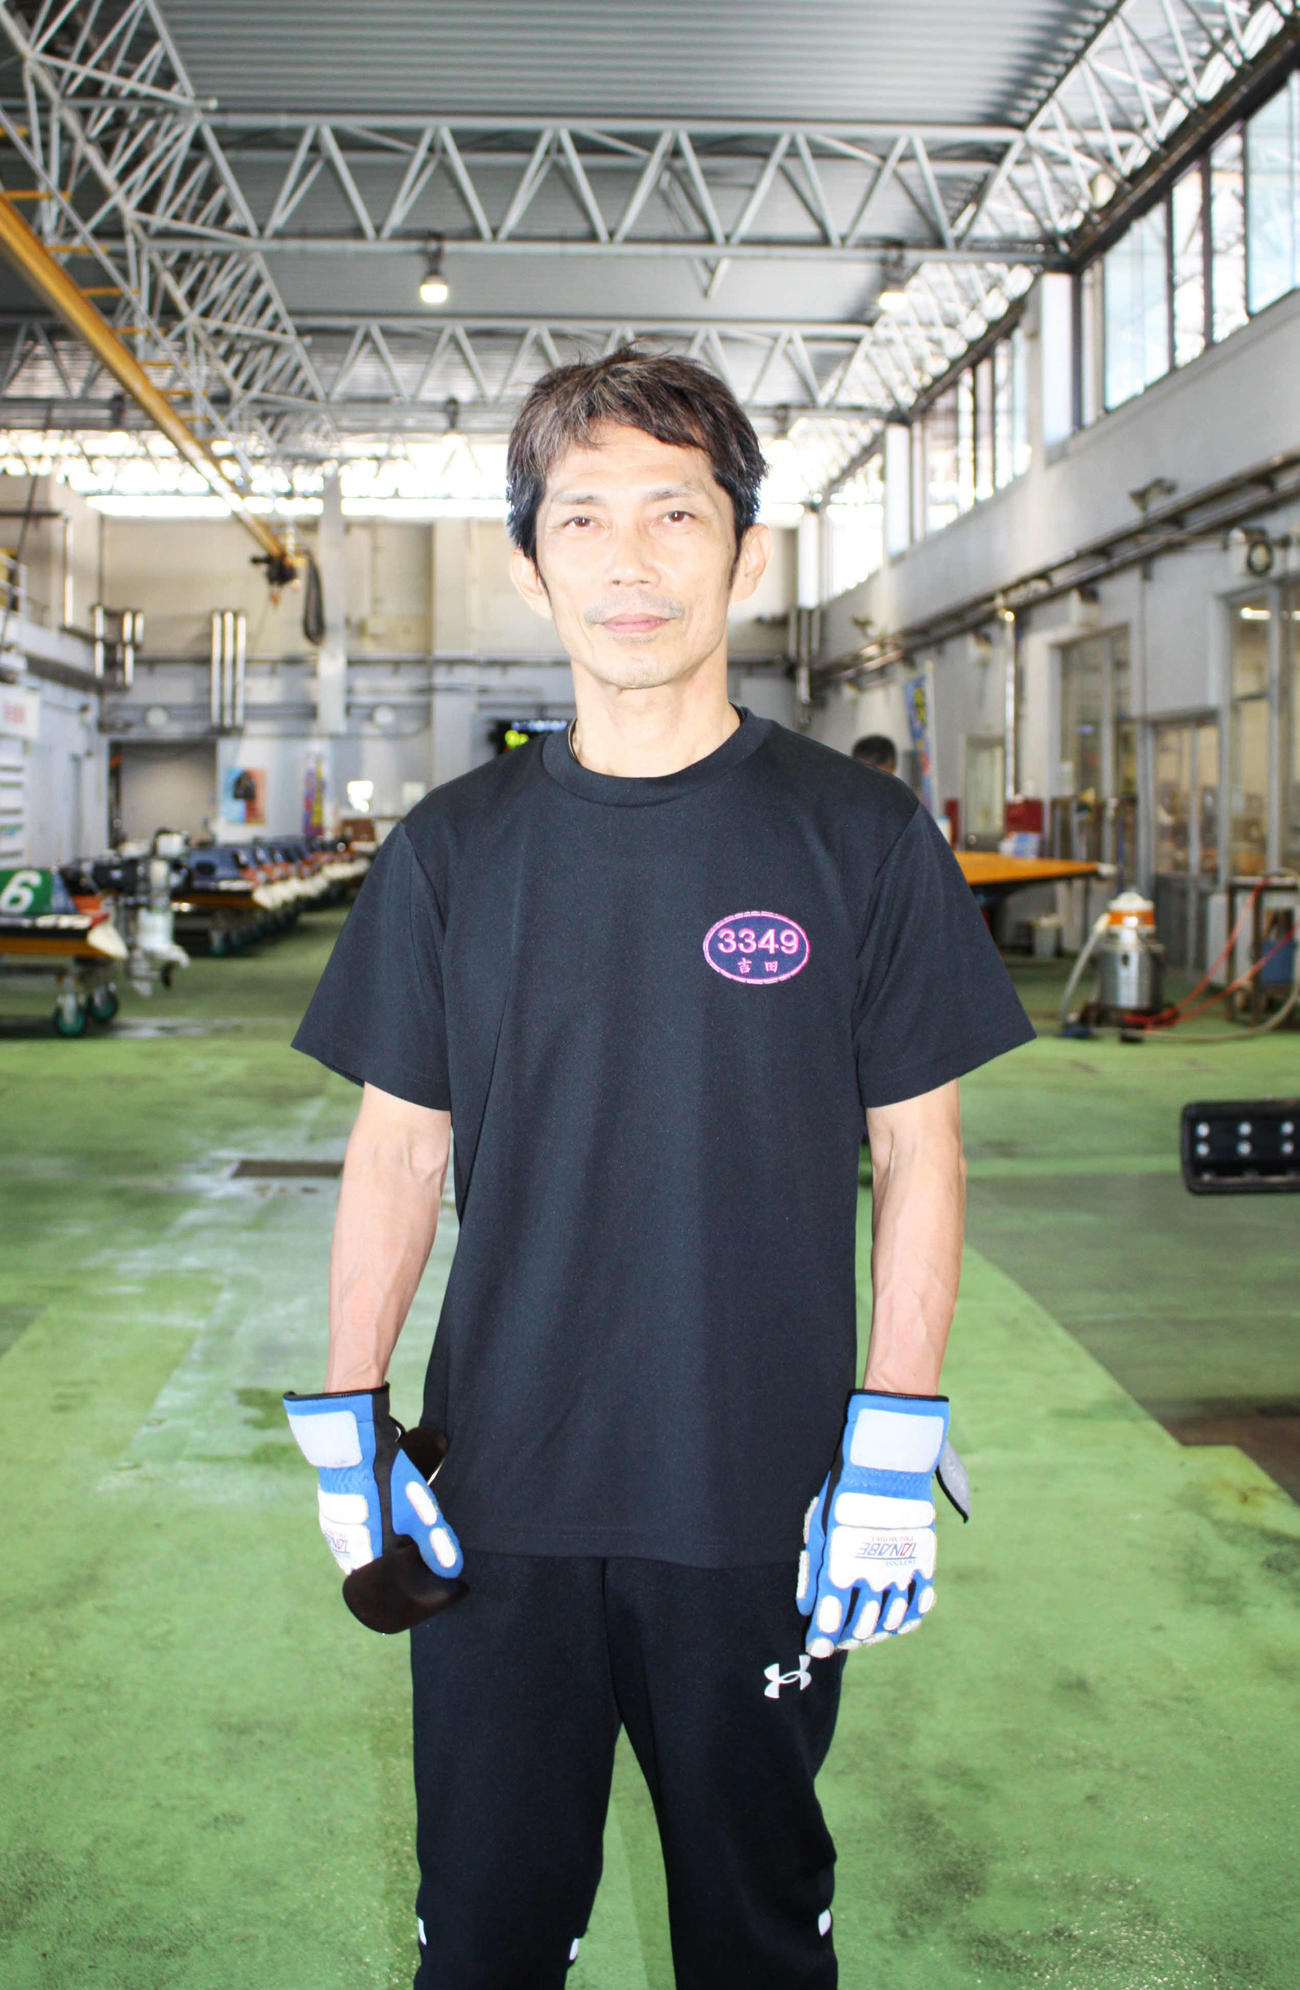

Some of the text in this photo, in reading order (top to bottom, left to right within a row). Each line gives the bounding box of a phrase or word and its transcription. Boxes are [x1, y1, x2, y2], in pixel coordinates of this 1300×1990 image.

[0, 870, 42, 913] 6
[717, 927, 800, 955] 3349
[737, 957, 779, 974] 吉田
[857, 1542, 917, 1559] TANABE
